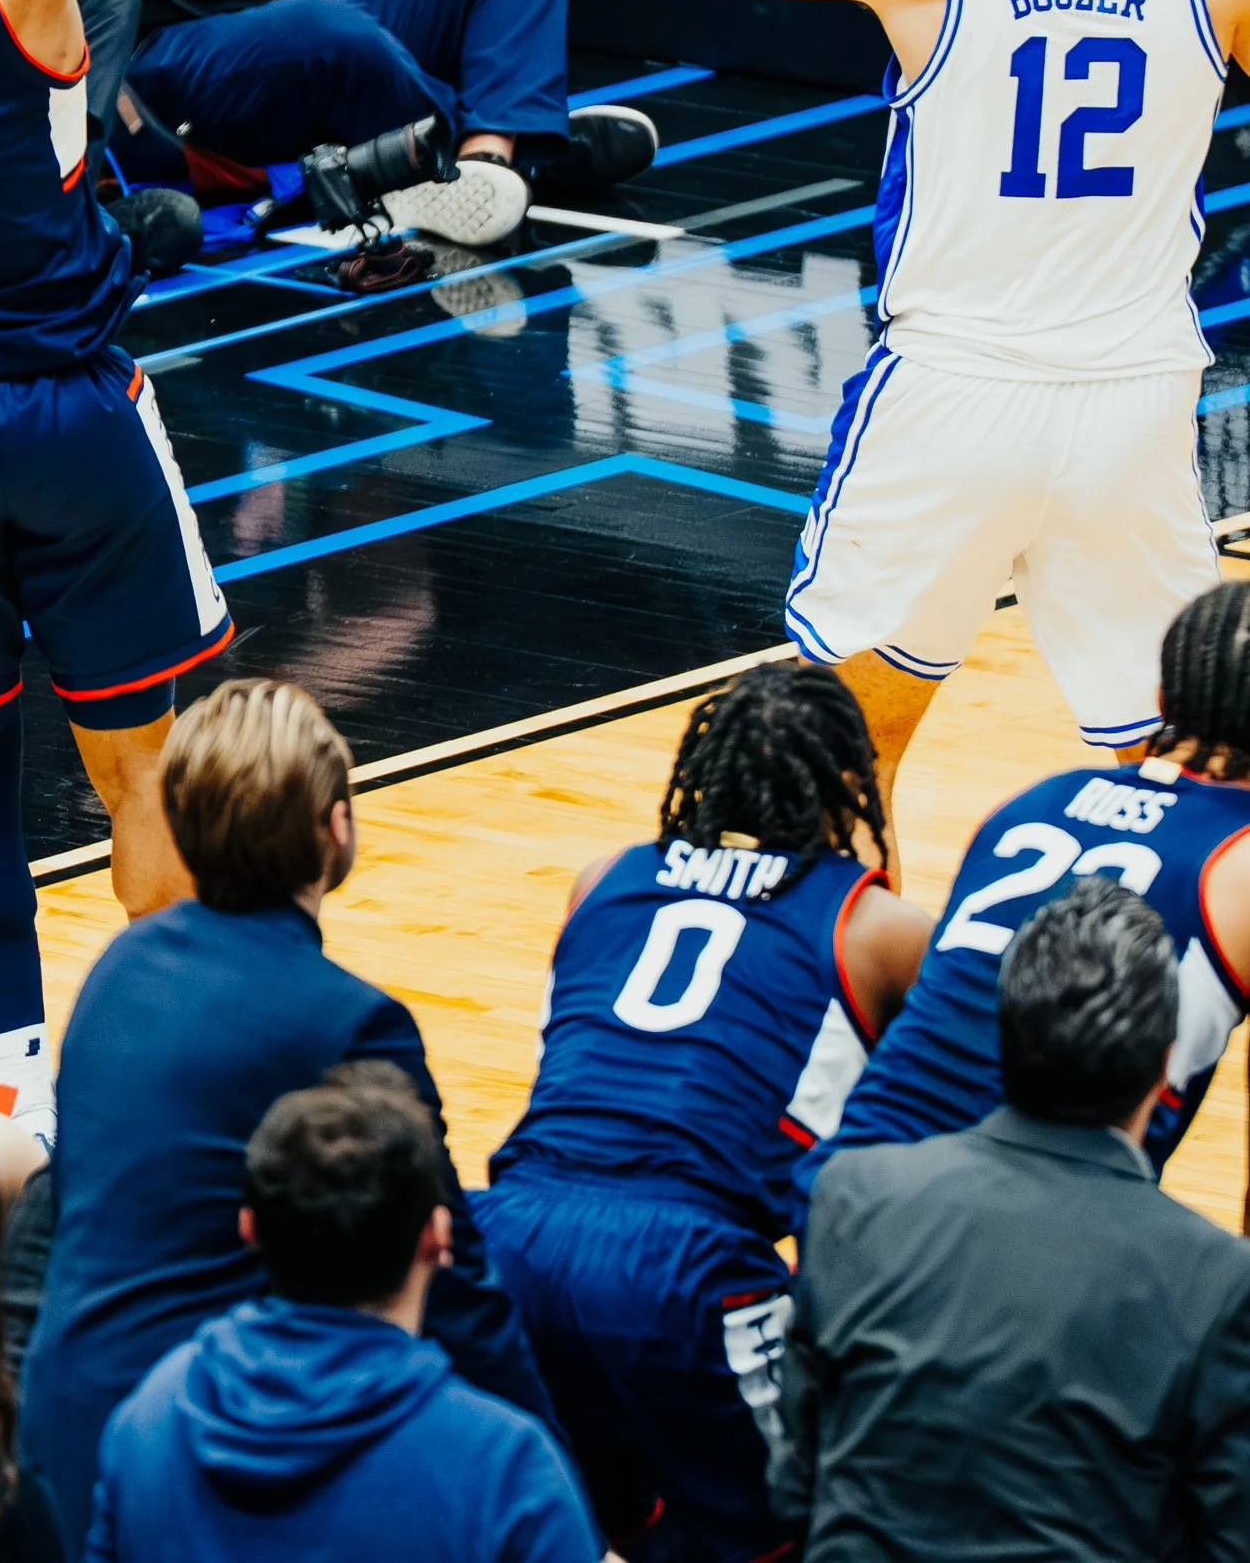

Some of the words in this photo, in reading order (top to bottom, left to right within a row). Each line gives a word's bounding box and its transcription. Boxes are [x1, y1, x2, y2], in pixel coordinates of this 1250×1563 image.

[998, 36, 1148, 199] 12
[1064, 777, 1178, 835] ROSS
[656, 840, 788, 900] SMITH
[612, 898, 747, 1033] 0
